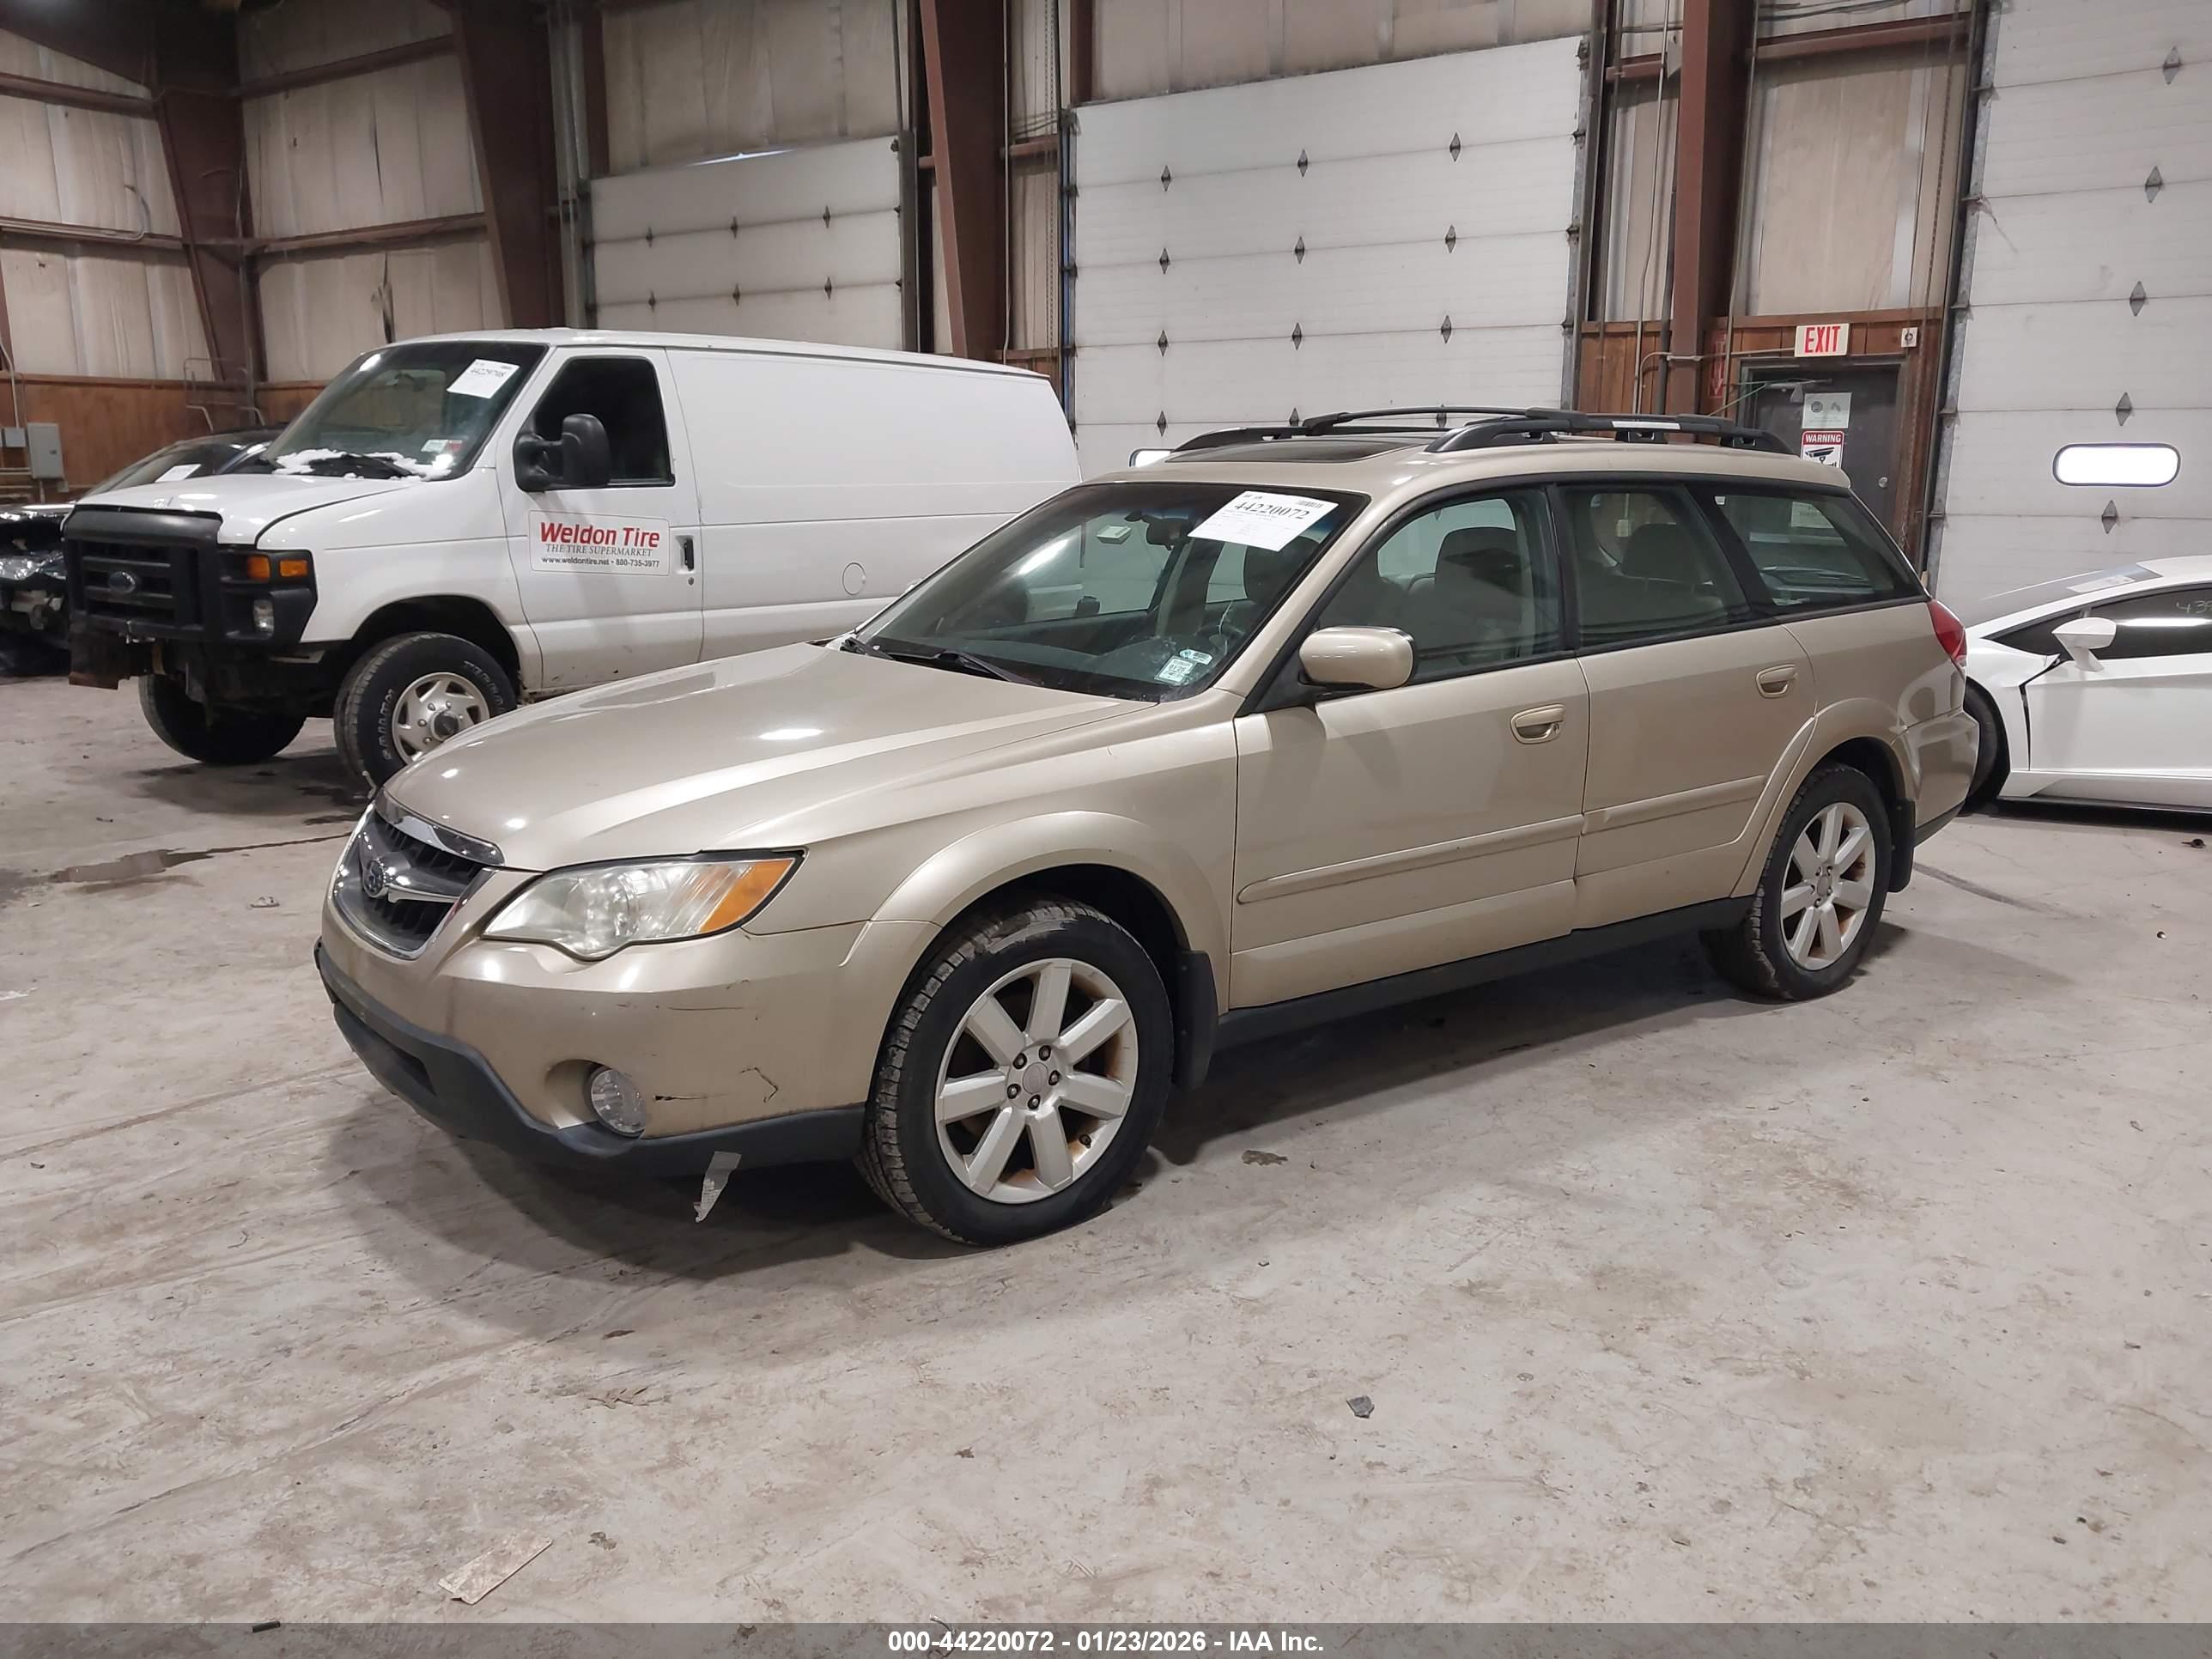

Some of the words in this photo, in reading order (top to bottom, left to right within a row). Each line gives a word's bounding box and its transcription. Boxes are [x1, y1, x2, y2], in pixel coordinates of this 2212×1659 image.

[1804, 325, 1841, 353] EXIT
[1805, 434, 1841, 443] WARNING
[1235, 501, 1310, 520] 44220072
[540, 522, 617, 546] Weldon
[623, 527, 660, 548] Tire
[546, 544, 564, 553] THE
[567, 545, 587, 554] TIRE
[589, 547, 653, 557] SUPERMARKET
[542, 557, 610, 567] www.weldontire.net
[616, 559, 660, 568] 800-735-3977
